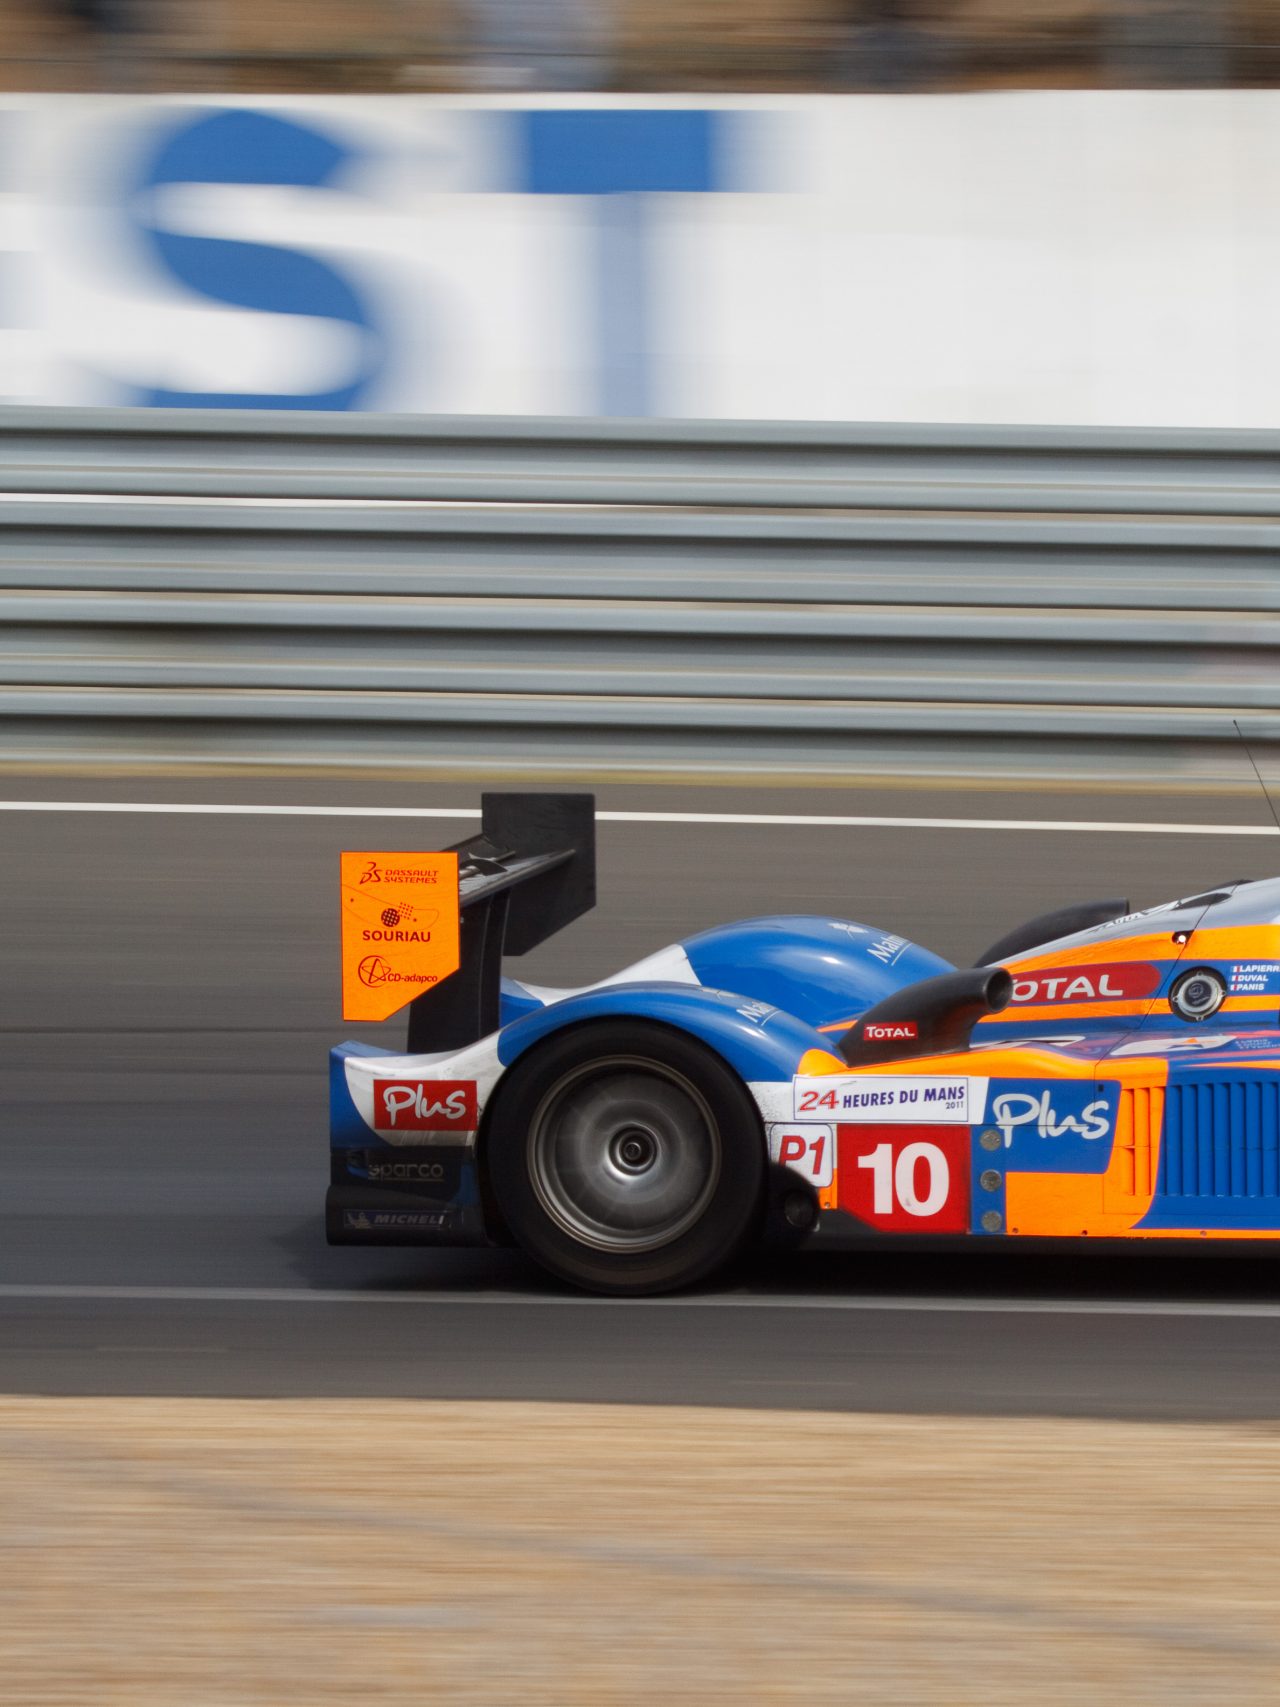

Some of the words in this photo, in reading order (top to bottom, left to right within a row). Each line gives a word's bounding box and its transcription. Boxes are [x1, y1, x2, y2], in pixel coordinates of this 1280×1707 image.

[0, 105, 790, 415] ST
[385, 869, 439, 877] DASSAULT
[362, 930, 431, 943] SOURIAU
[387, 973, 438, 984] CD-adapco
[1011, 973, 1124, 1002] OTAL
[1238, 974, 1269, 982] DUVAL
[866, 1025, 915, 1038] TOTAL
[383, 1083, 466, 1126] Plus
[798, 1090, 839, 1111] 24
[843, 1091, 894, 1109] HEURES
[900, 1089, 919, 1103] DU
[924, 1086, 965, 1102] MANS
[945, 1100, 964, 1110] 2011
[993, 1090, 1110, 1148] Plus
[778, 1135, 826, 1175] P1
[368, 1163, 444, 1180] sparco
[857, 1141, 950, 1217] 10
